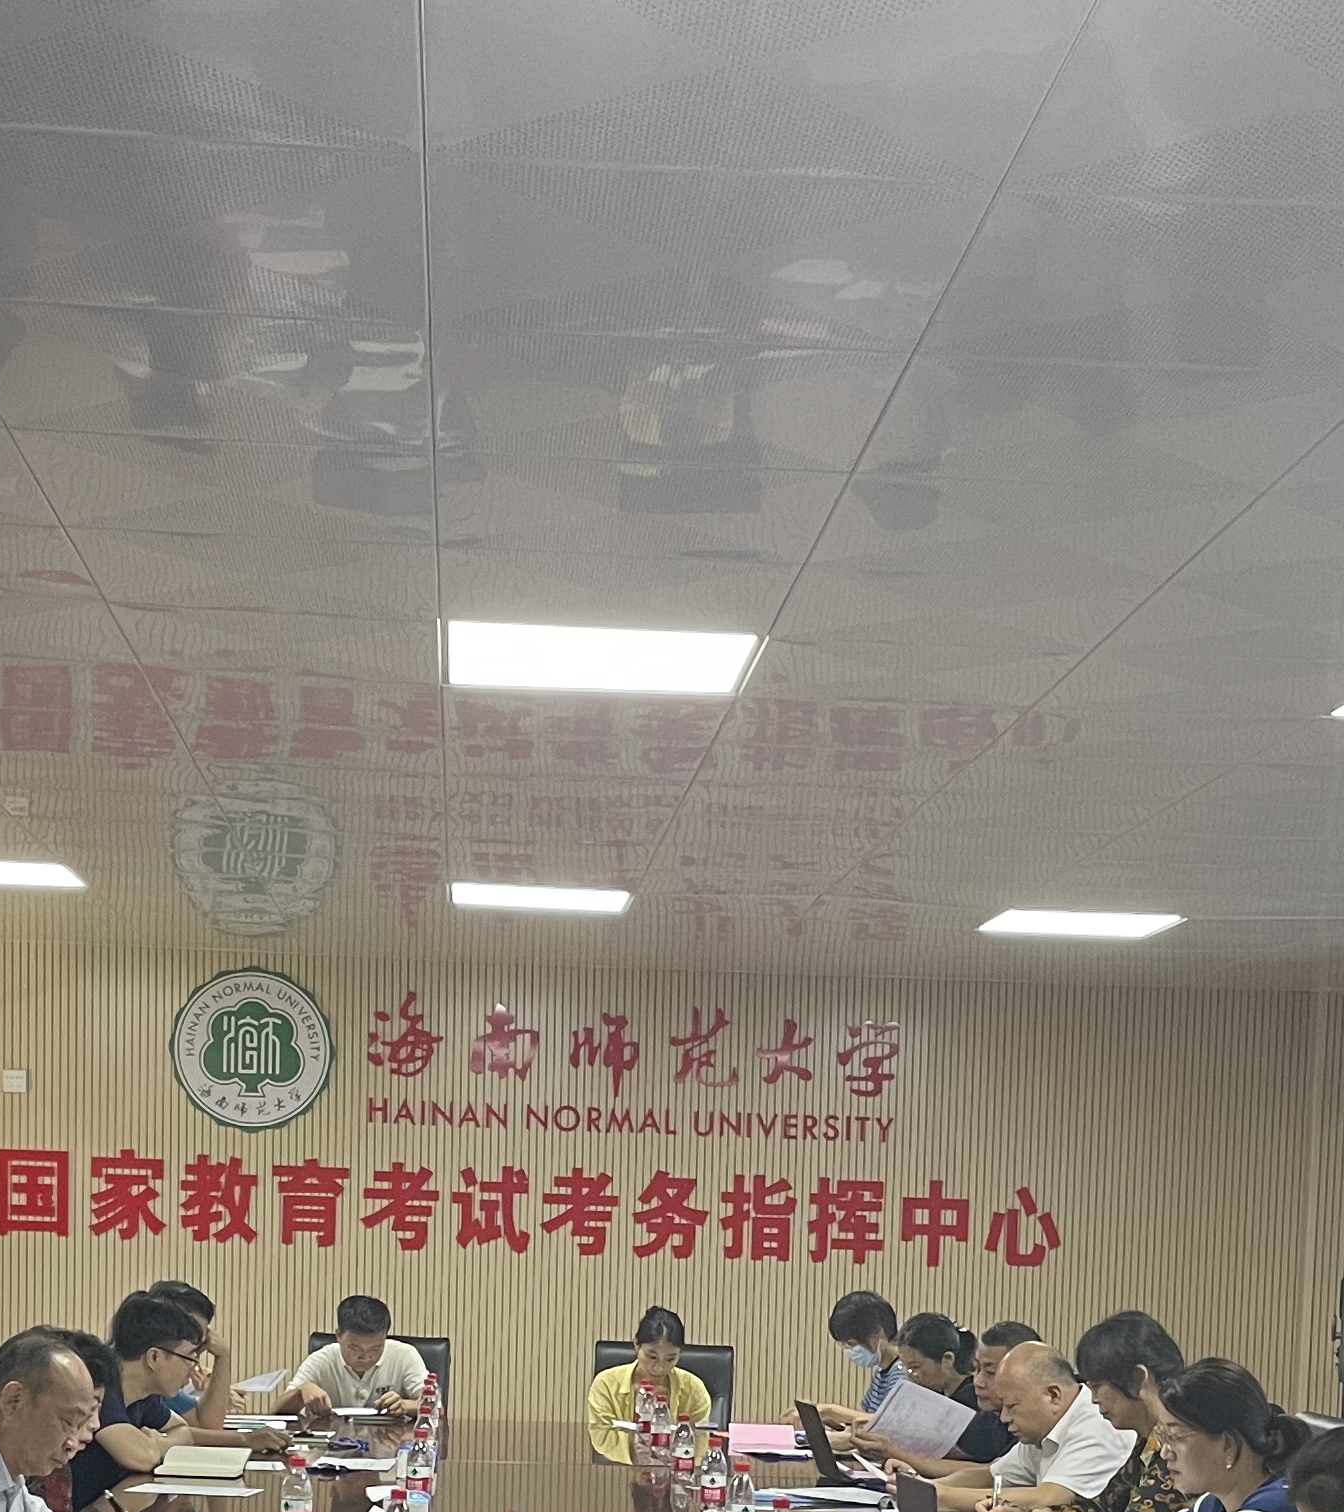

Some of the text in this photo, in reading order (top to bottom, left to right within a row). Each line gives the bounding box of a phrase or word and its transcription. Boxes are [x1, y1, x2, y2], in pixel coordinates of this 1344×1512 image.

[185, 981, 321, 1062] HAINAN NORMAL UNIVERSITY
[368, 991, 902, 1098] 海南师范大学
[367, 1097, 895, 1144] HAINAN NORMAL UNIVERSITY
